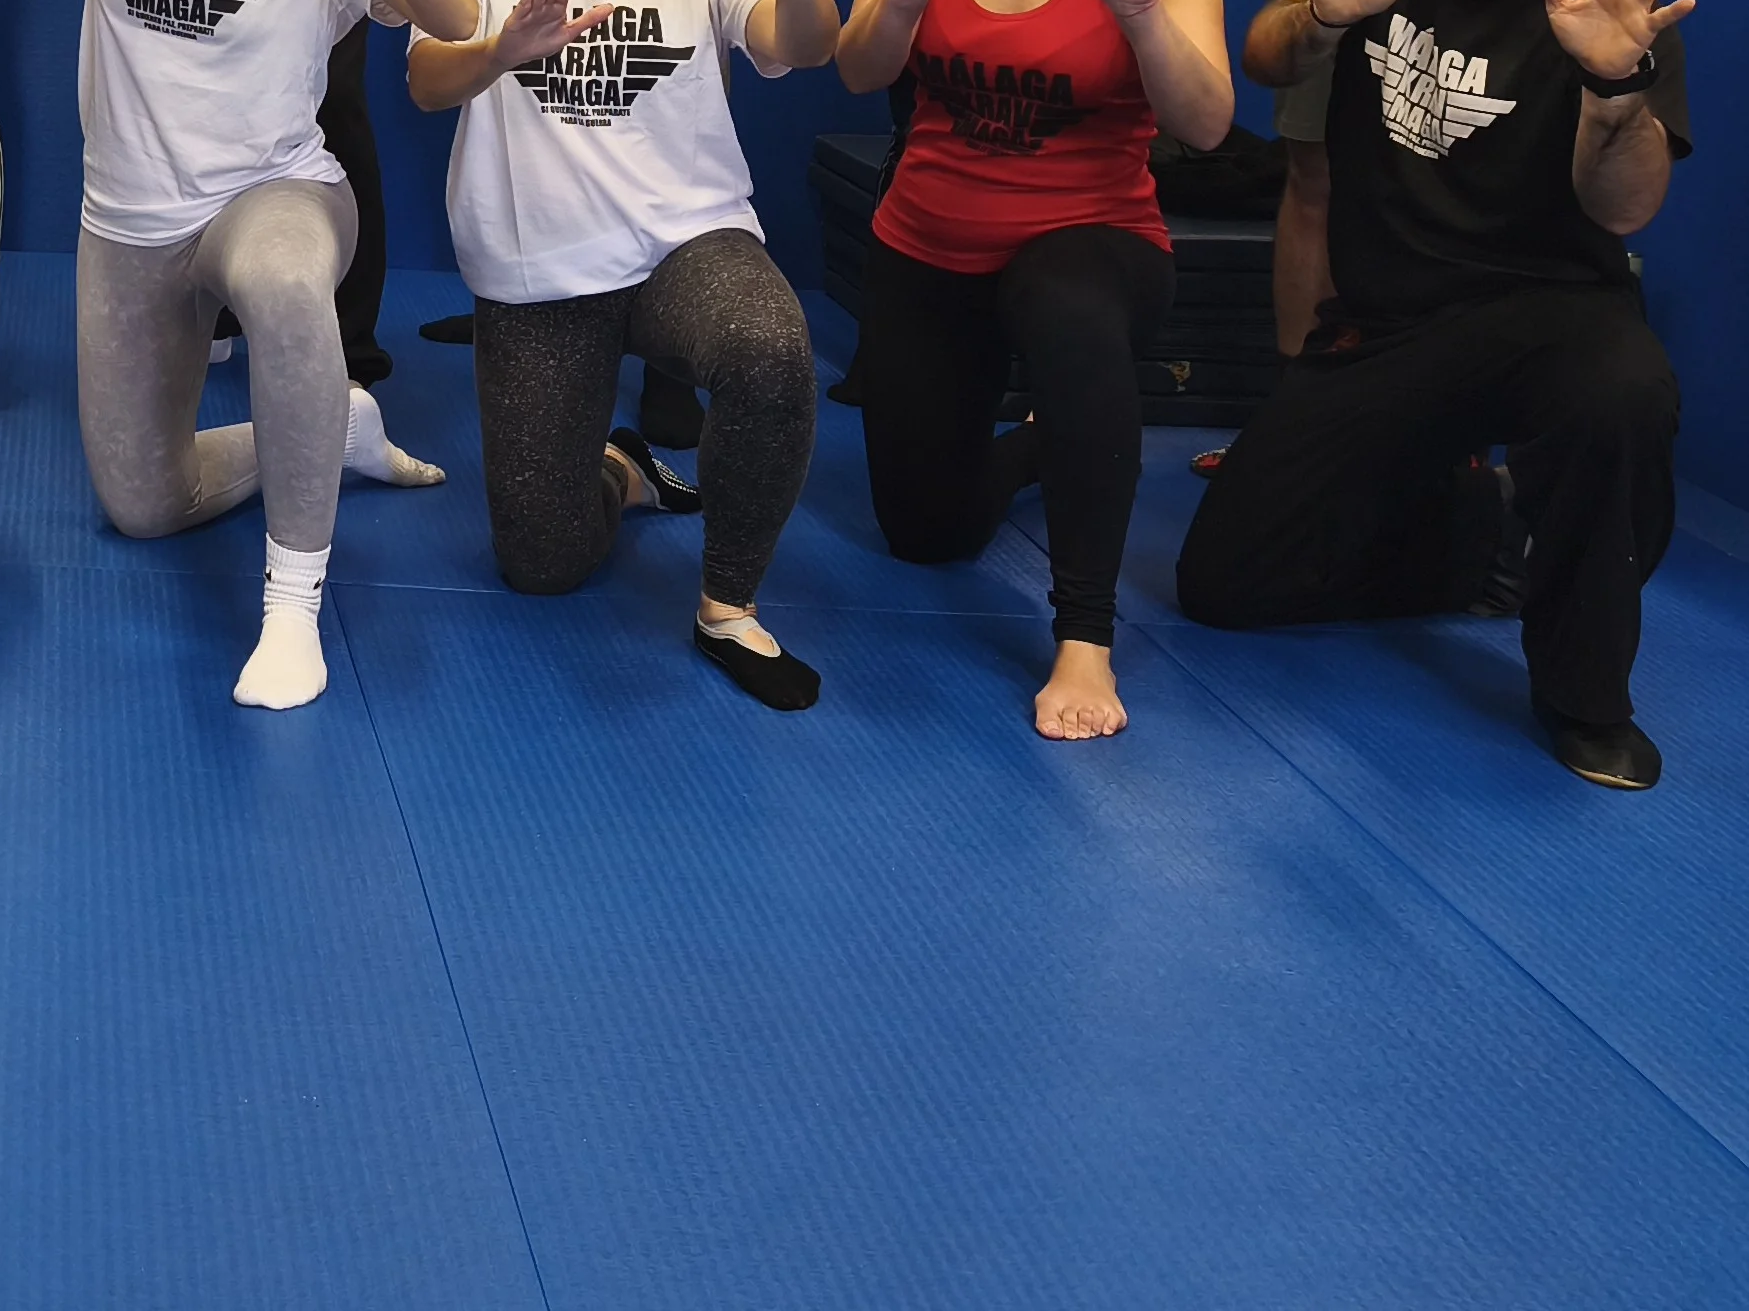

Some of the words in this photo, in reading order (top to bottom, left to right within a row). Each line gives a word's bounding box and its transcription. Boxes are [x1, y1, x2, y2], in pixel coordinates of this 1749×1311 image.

[545, 45, 626, 77] KRAV
[917, 50, 1073, 106] MÁLAGA
[548, 77, 621, 106] MAGA
[1388, 94, 1443, 144] MAGA
